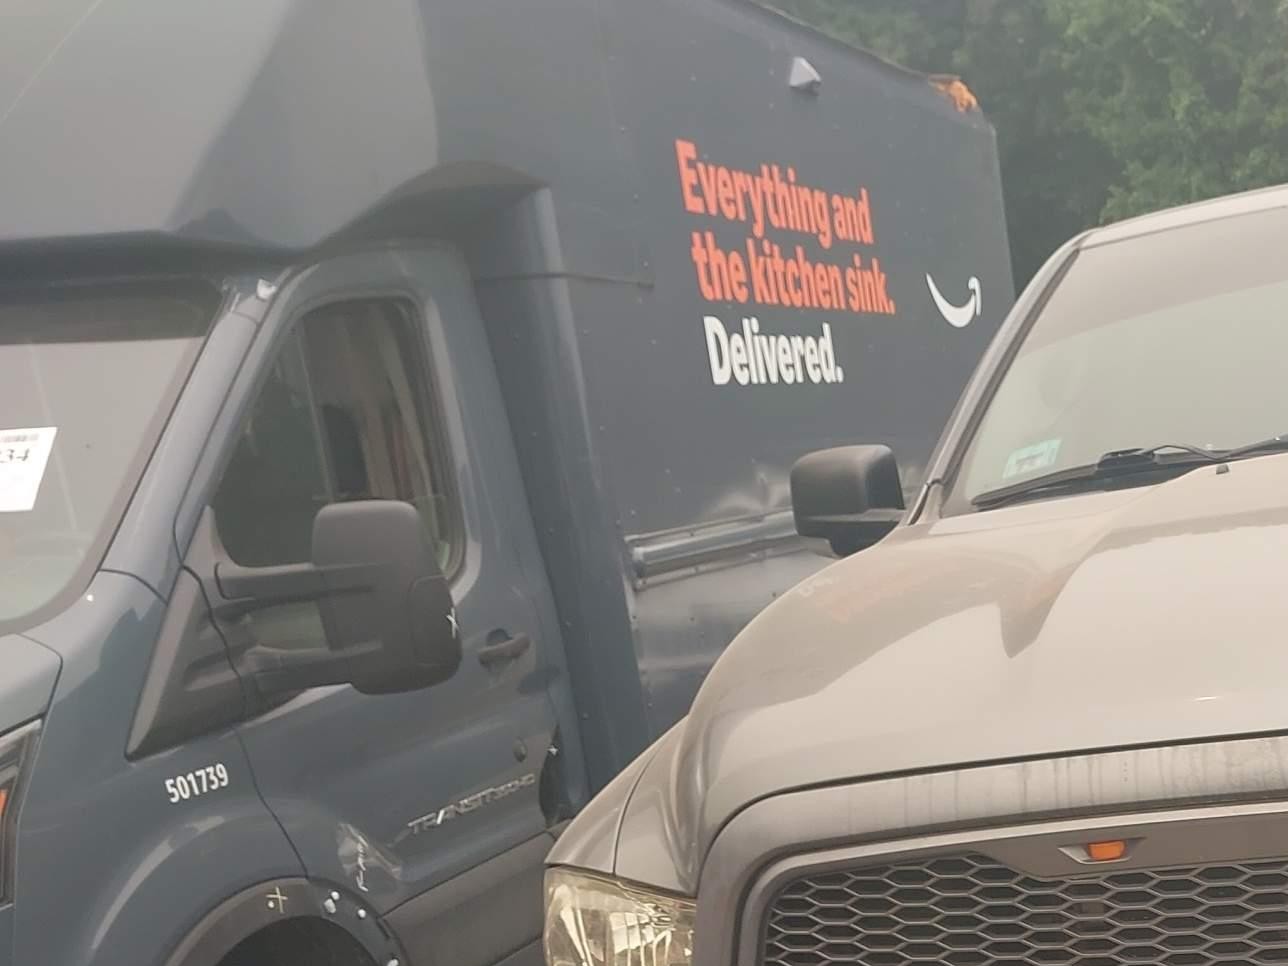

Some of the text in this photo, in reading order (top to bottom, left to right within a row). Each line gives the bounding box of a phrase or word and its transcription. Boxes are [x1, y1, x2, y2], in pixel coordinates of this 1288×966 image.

[675, 139, 874, 249] Everything and
[691, 231, 895, 315] the kitchen sink.
[703, 315, 844, 385] Delivered.
[165, 763, 229, 803] 501739
